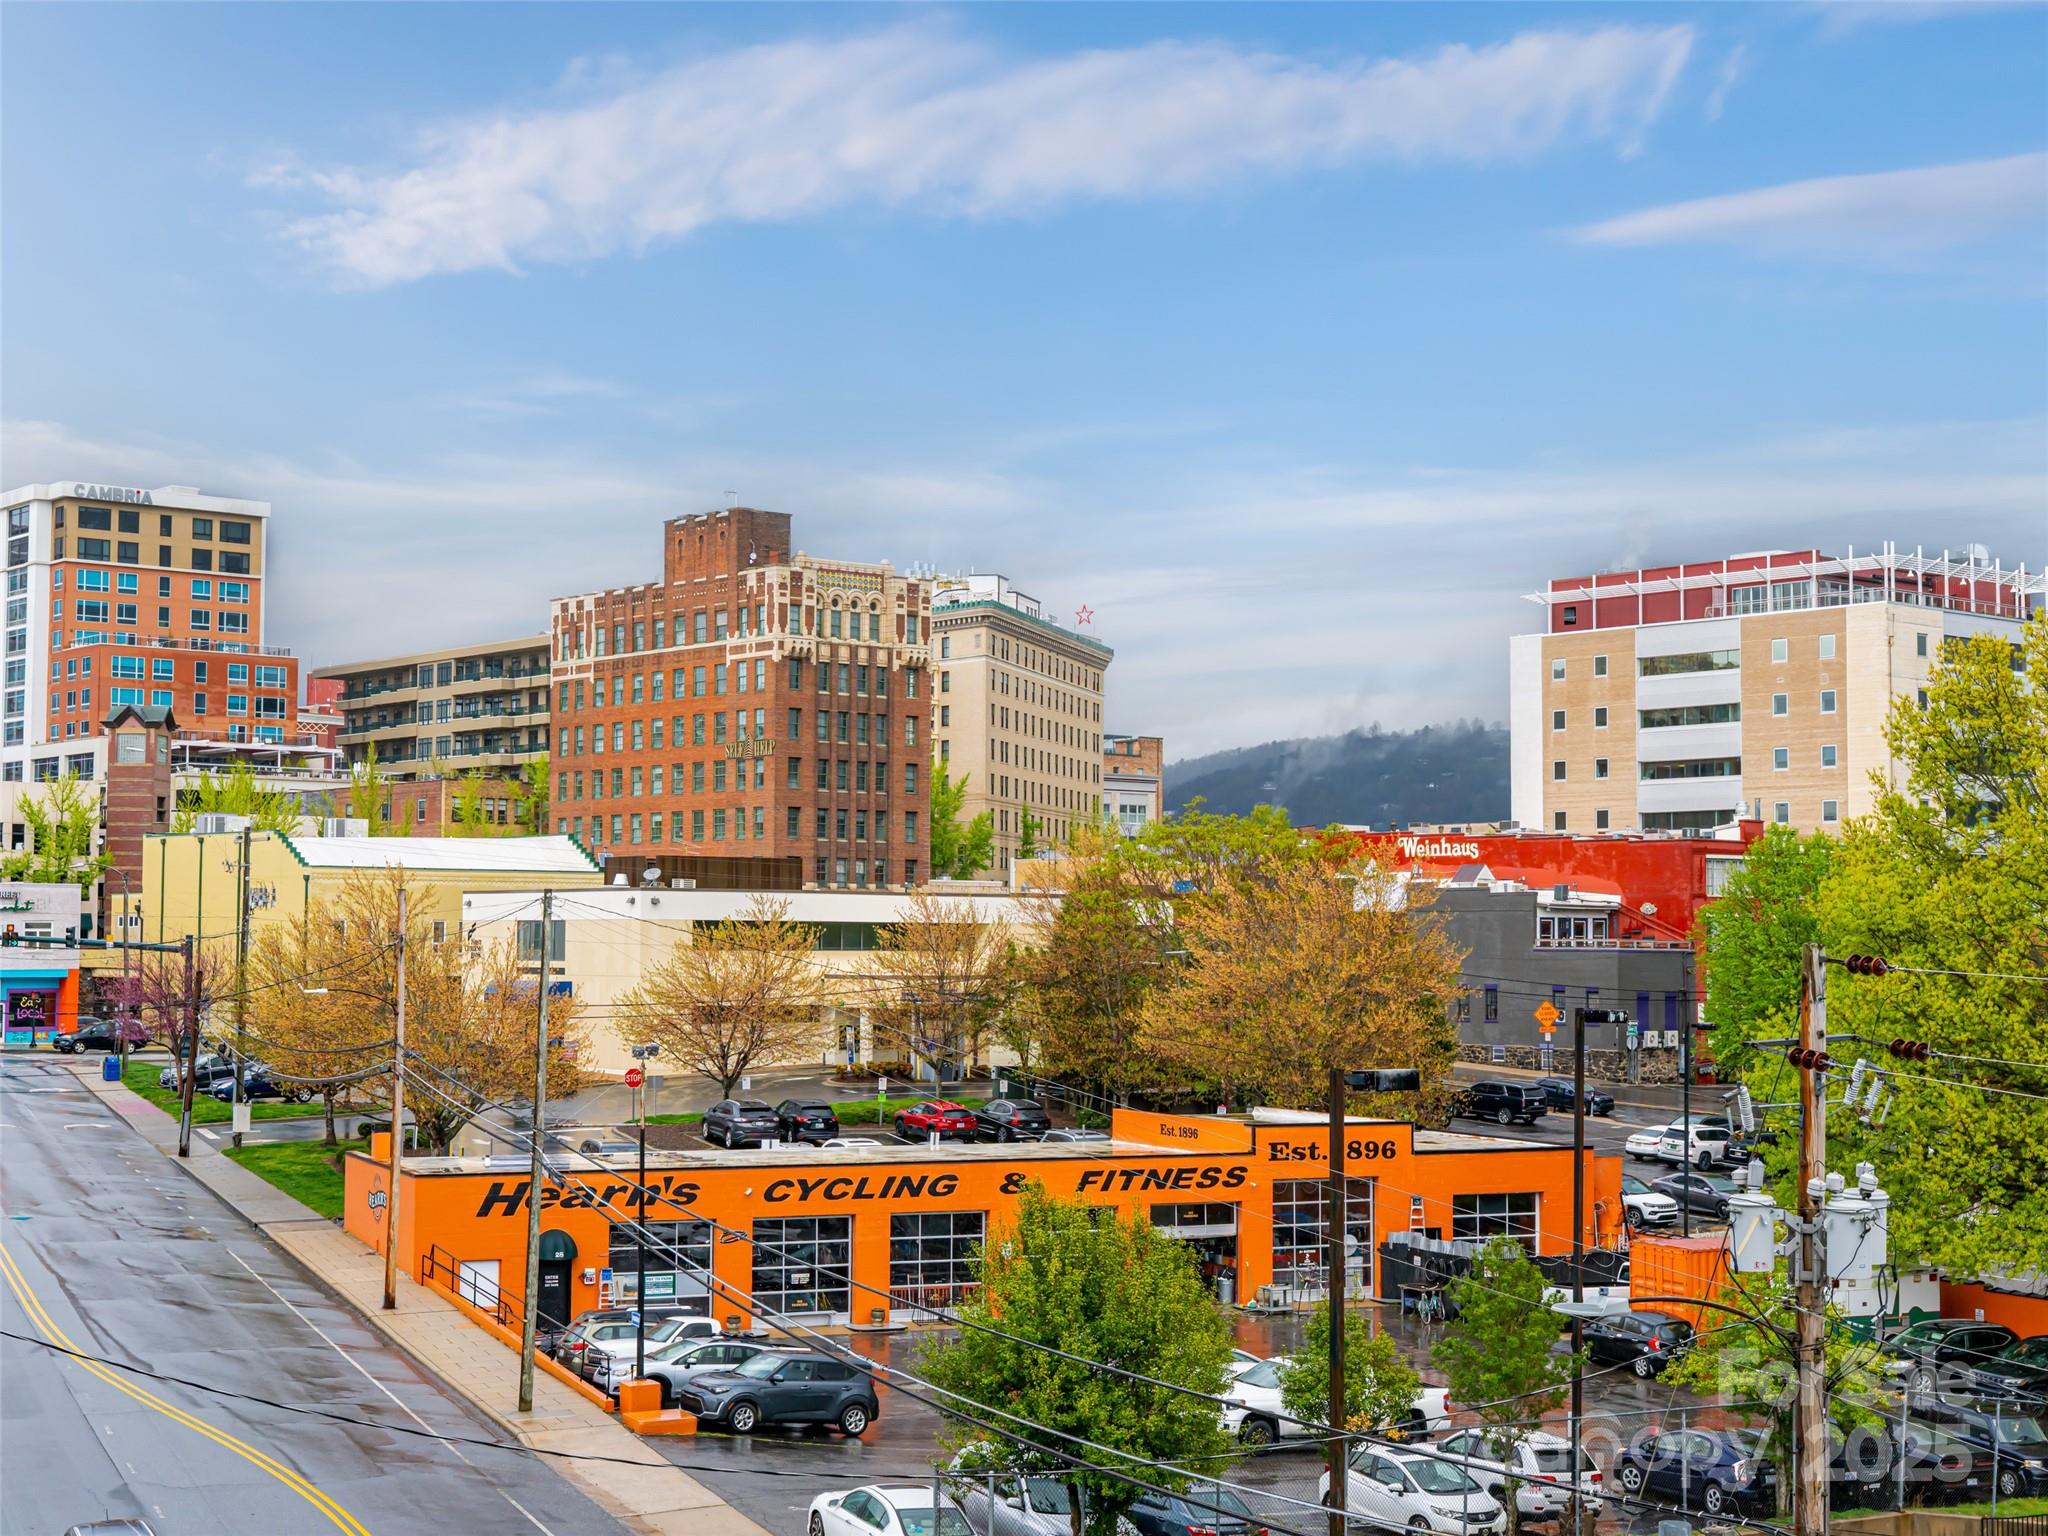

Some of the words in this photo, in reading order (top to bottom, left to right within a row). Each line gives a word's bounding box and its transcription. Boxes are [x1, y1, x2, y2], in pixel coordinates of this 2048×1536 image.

[754, 740, 776, 756] HELP
[1398, 837, 1479, 859] Weinhaus
[1160, 1124, 1177, 1137] Est.
[1179, 1126, 1199, 1139] 1896
[1268, 1142, 1328, 1161] Est.
[1341, 1141, 1397, 1160] 896
[476, 1176, 701, 1218] Hearn's
[764, 1174, 959, 1202] CYCLING
[1000, 1172, 1028, 1195] &
[1076, 1167, 1249, 1192] FITNESS
